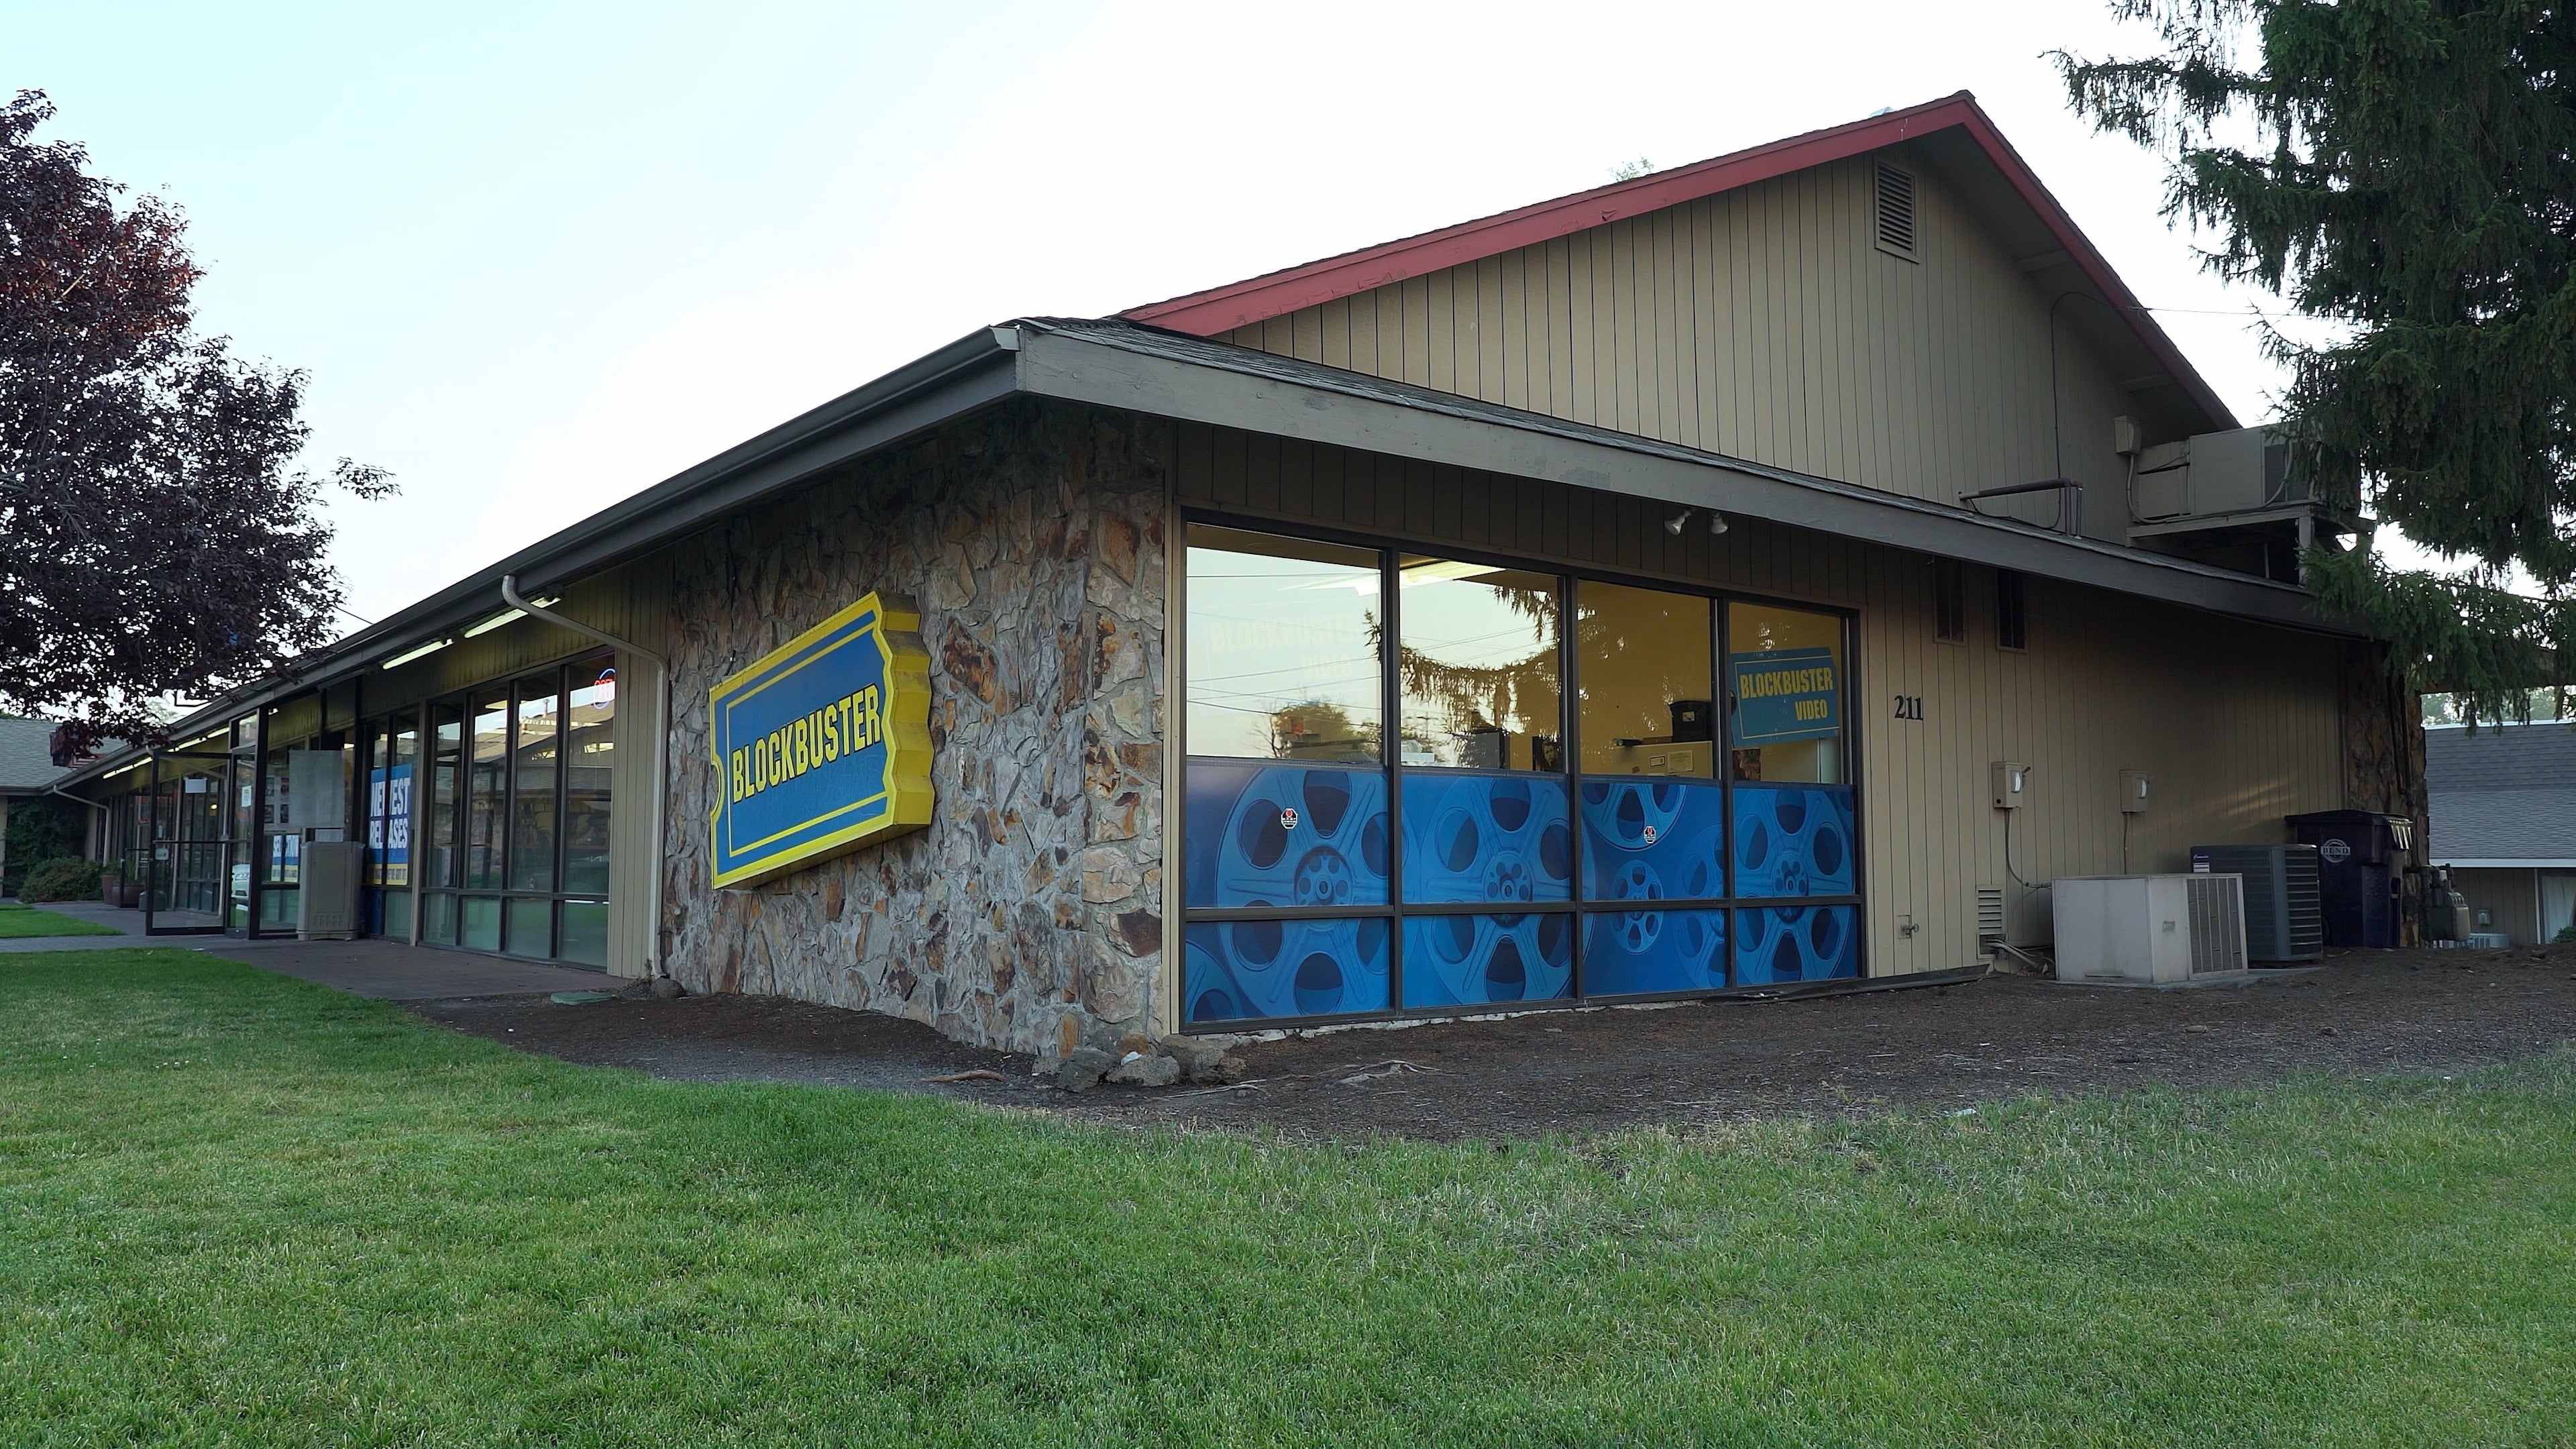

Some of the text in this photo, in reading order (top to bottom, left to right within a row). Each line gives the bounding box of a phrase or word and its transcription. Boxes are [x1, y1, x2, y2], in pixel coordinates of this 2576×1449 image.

[1739, 667, 1833, 699] BLOCKBUSTER
[1794, 698, 1829, 721] VIDEO
[1894, 694, 1923, 720] 211
[732, 684, 881, 804] BLOCKBUSTER
[369, 818, 409, 850] RELASES
[2322, 847, 2349, 855] BEND
